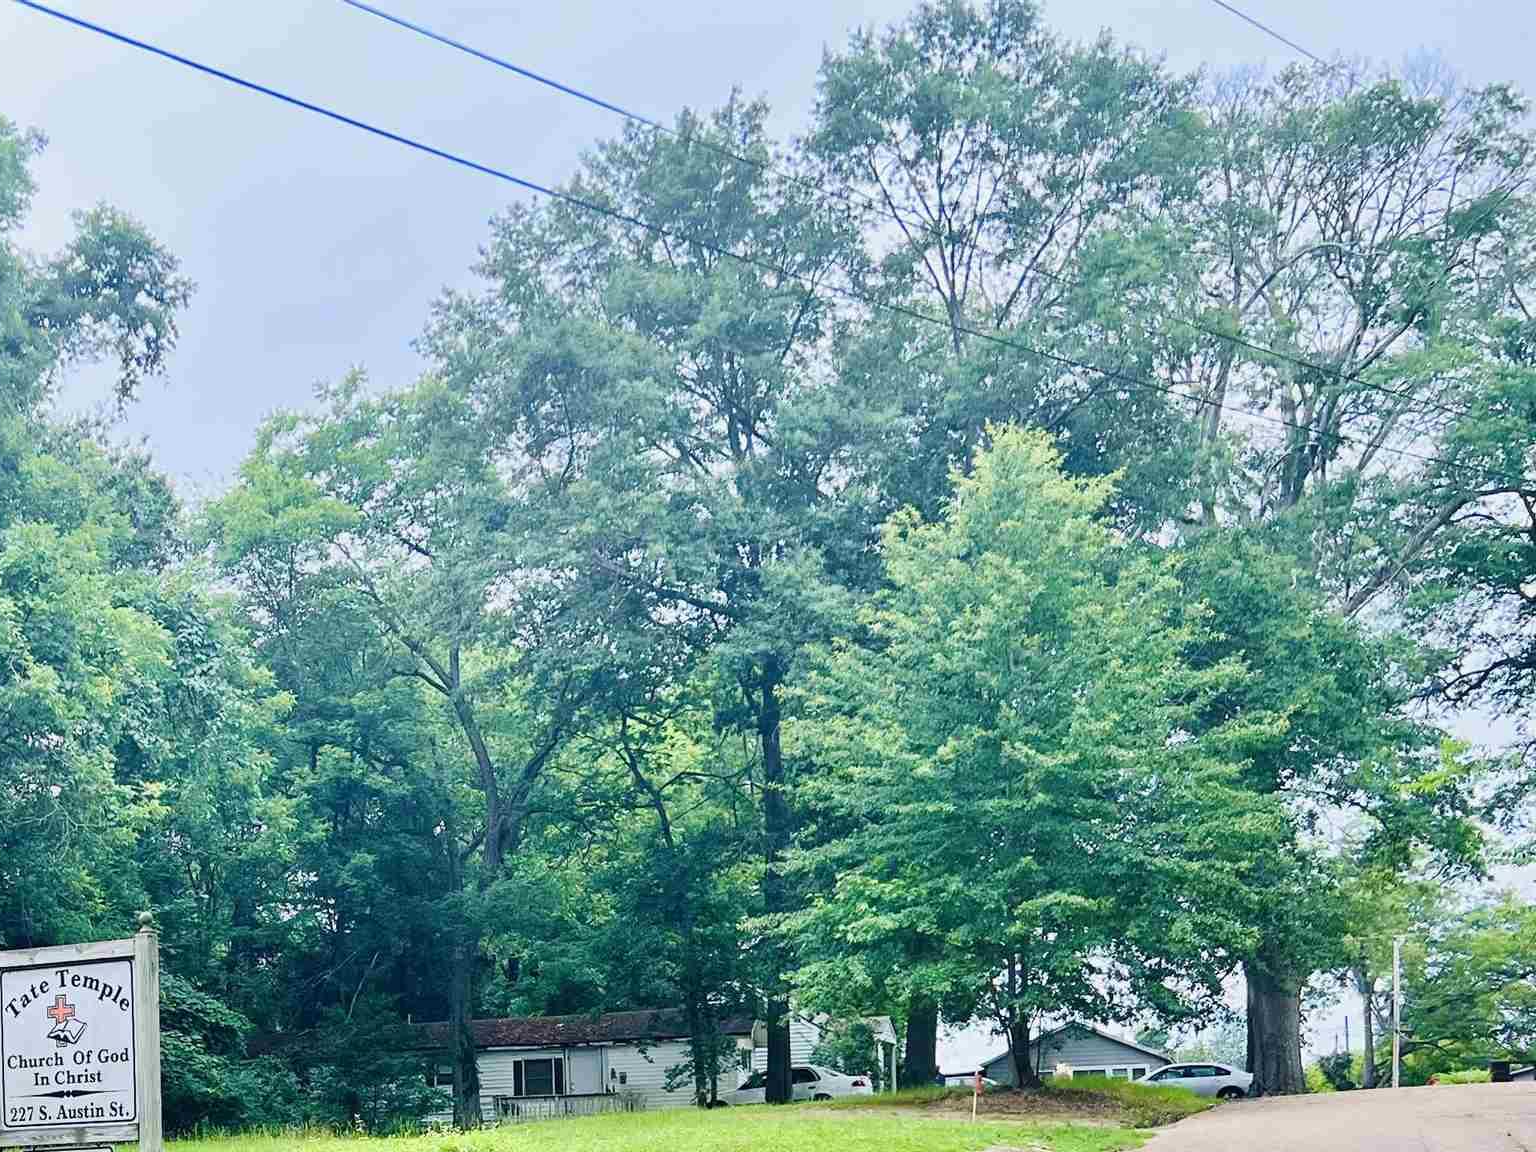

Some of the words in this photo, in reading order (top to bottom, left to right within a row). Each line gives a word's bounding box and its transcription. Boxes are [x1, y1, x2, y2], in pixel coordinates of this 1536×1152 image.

[5, 980, 49, 1018] Tate
[56, 970, 130, 1011] Temple
[8, 1053, 64, 1069] Church
[73, 1051, 92, 1064] Of
[98, 1048, 129, 1062] God
[33, 1072, 49, 1086] In
[55, 1070, 102, 1084] Christ
[10, 1107, 33, 1122] 227
[40, 1106, 52, 1121] S.
[56, 1103, 104, 1119] Austin
[110, 1101, 129, 1118] St.
